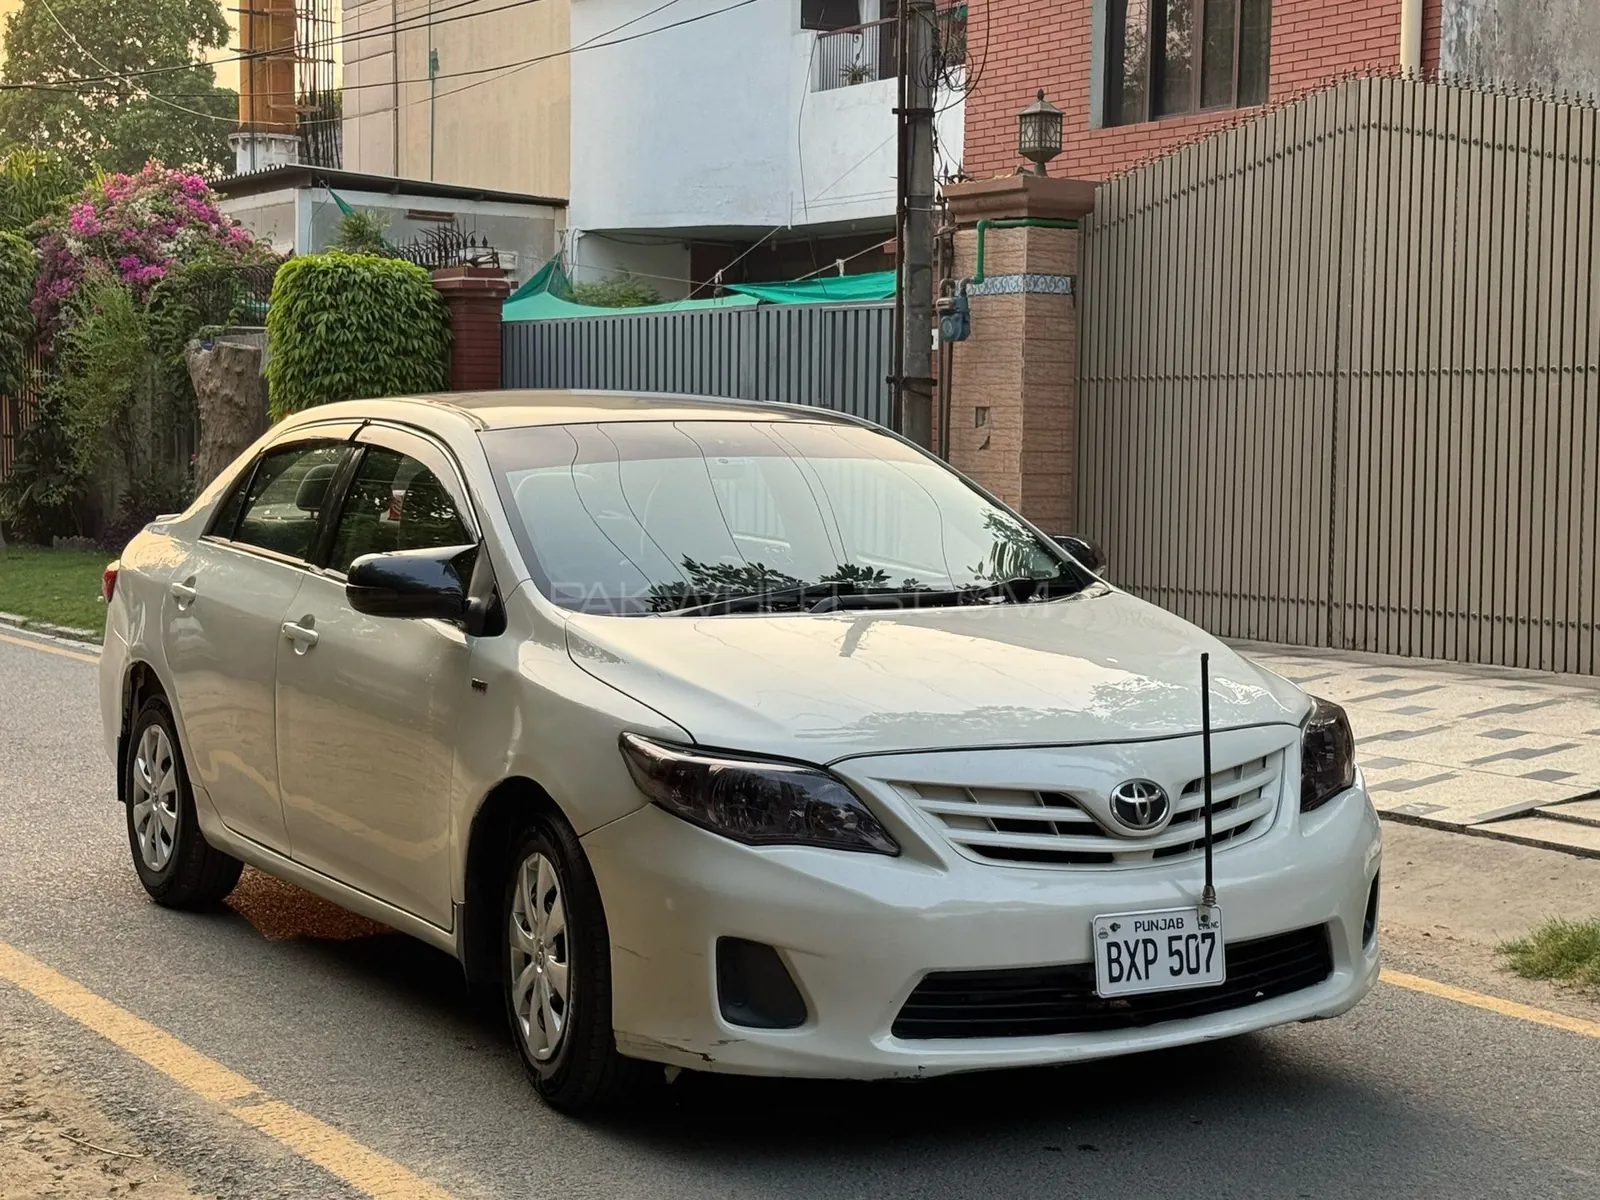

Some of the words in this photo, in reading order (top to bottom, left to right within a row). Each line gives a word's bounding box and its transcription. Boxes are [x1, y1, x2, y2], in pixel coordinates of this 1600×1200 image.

[1134, 917, 1184, 932] PUNJAB
[1106, 938, 1158, 983] BXP
[1168, 932, 1215, 976] 507
